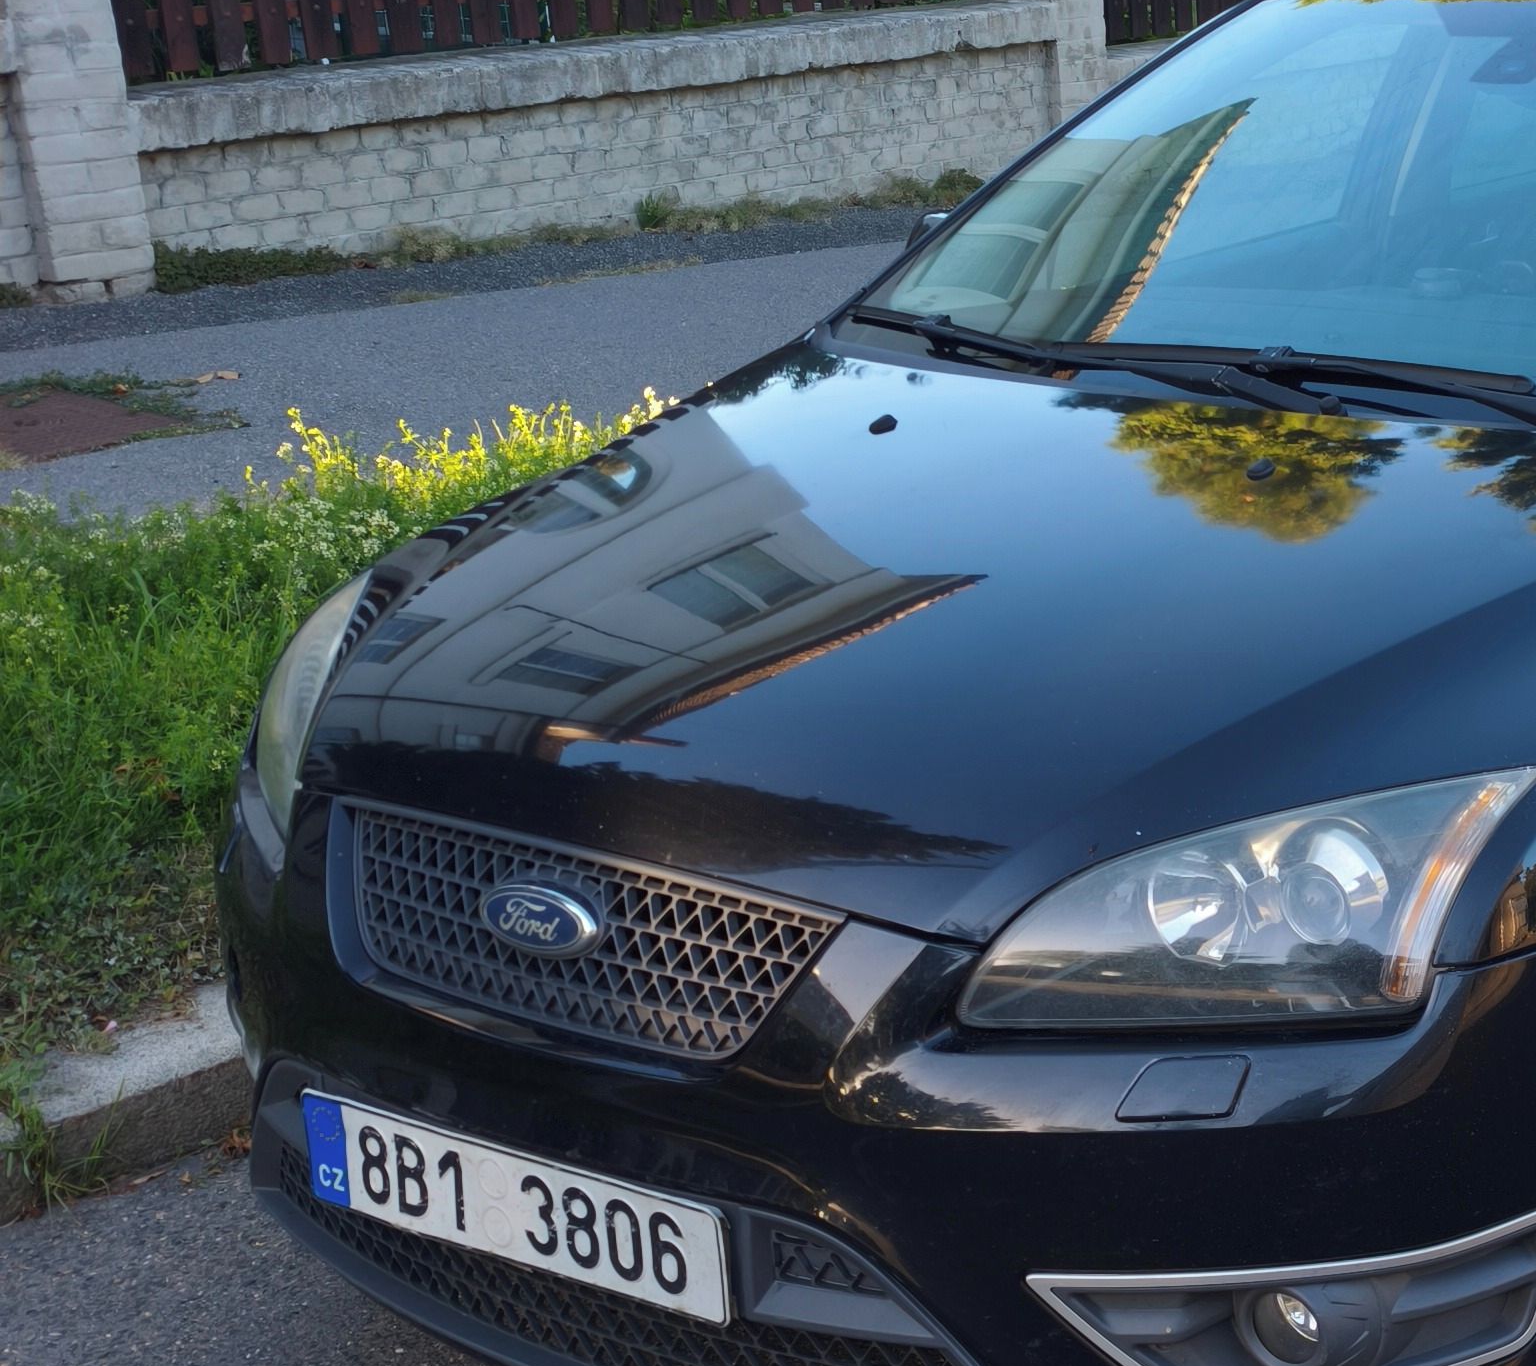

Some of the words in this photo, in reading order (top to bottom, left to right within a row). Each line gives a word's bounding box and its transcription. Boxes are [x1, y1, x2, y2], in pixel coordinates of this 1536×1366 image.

[500, 898, 560, 941] Ford
[318, 1163, 345, 1192] CZ
[359, 1125, 466, 1232] 8B1
[521, 1175, 687, 1294] 3806
